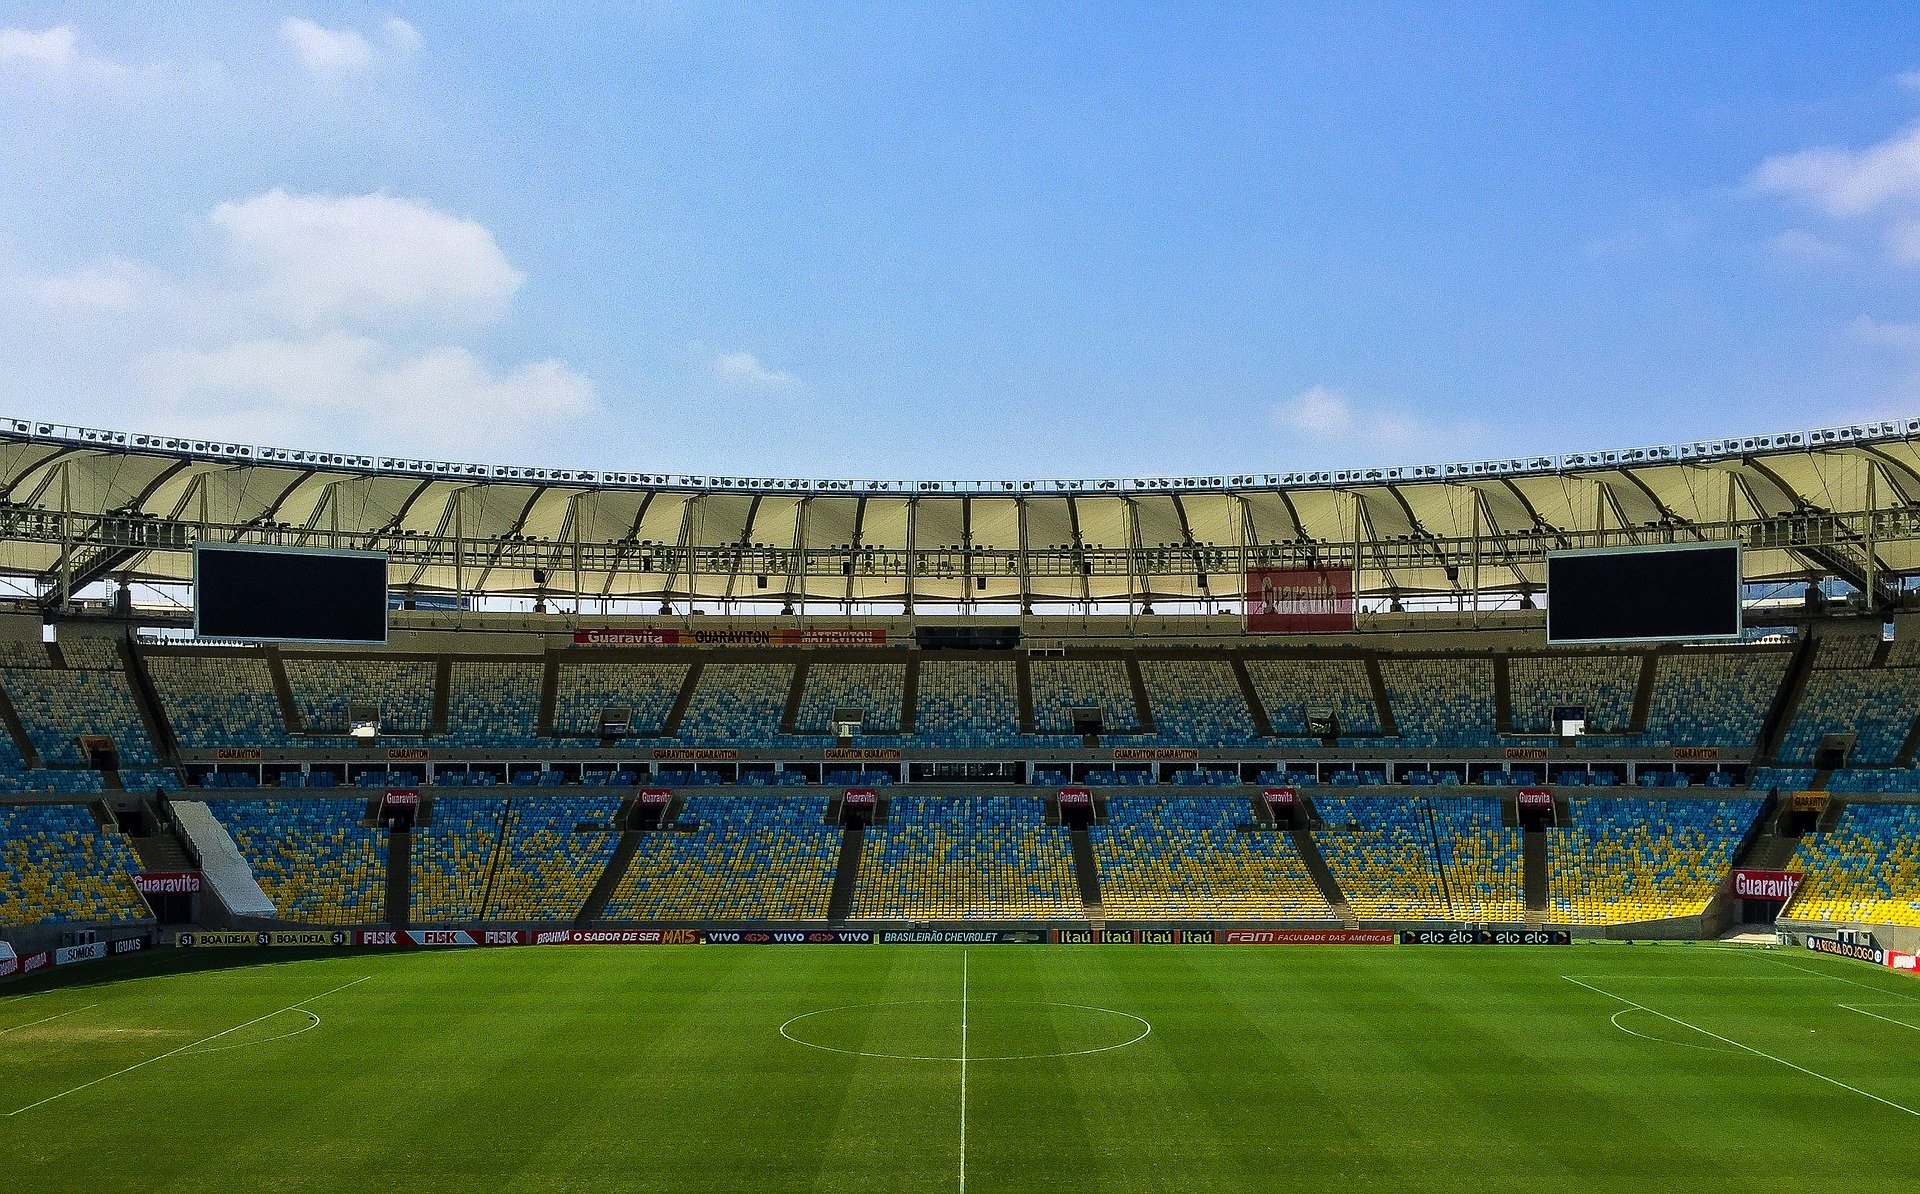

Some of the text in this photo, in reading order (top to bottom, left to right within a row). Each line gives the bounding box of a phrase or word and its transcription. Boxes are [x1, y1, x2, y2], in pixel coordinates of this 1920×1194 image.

[588, 630, 663, 644] Guaravita
[694, 630, 770, 644] GUARAVITON
[218, 749, 261, 759] GUARAVITON
[388, 749, 428, 759] GUARAVITON
[653, 749, 737, 759] GUARAVITON GUARAVITON
[825, 749, 901, 759] GUARAVITON GUARAVITON
[1114, 749, 1197, 759] GUARAVITON GUARAVITON
[1506, 749, 1547, 759] GUARAVITON
[1674, 749, 1717, 759] GUARAVITON
[1519, 791, 1551, 803] Guaravita
[181, 934, 344, 945] 51 BOA IDEIA 51 BOA IDEIA 51
[363, 931, 397, 944] FISK
[424, 931, 458, 944] FISK
[485, 931, 519, 944] FISK
[537, 929, 696, 944] BRAHMA O SABOR DE SER MAIS
[884, 930, 998, 942] BRASILEIRÃO CHEVROLET
[1061, 930, 1091, 943] Itaú
[1101, 930, 1131, 943] Itaú
[1142, 930, 1172, 943] Itaú
[1182, 930, 1212, 943] Itaú
[1348, 933, 1392, 942] AMÉRICAS
[1420, 931, 1548, 943] elo elo elo elo
[115, 938, 141, 953] IGUAIS
[1815, 939, 1874, 960] A REGRA DO JOGO
[67, 946, 95, 961] SOMOS
